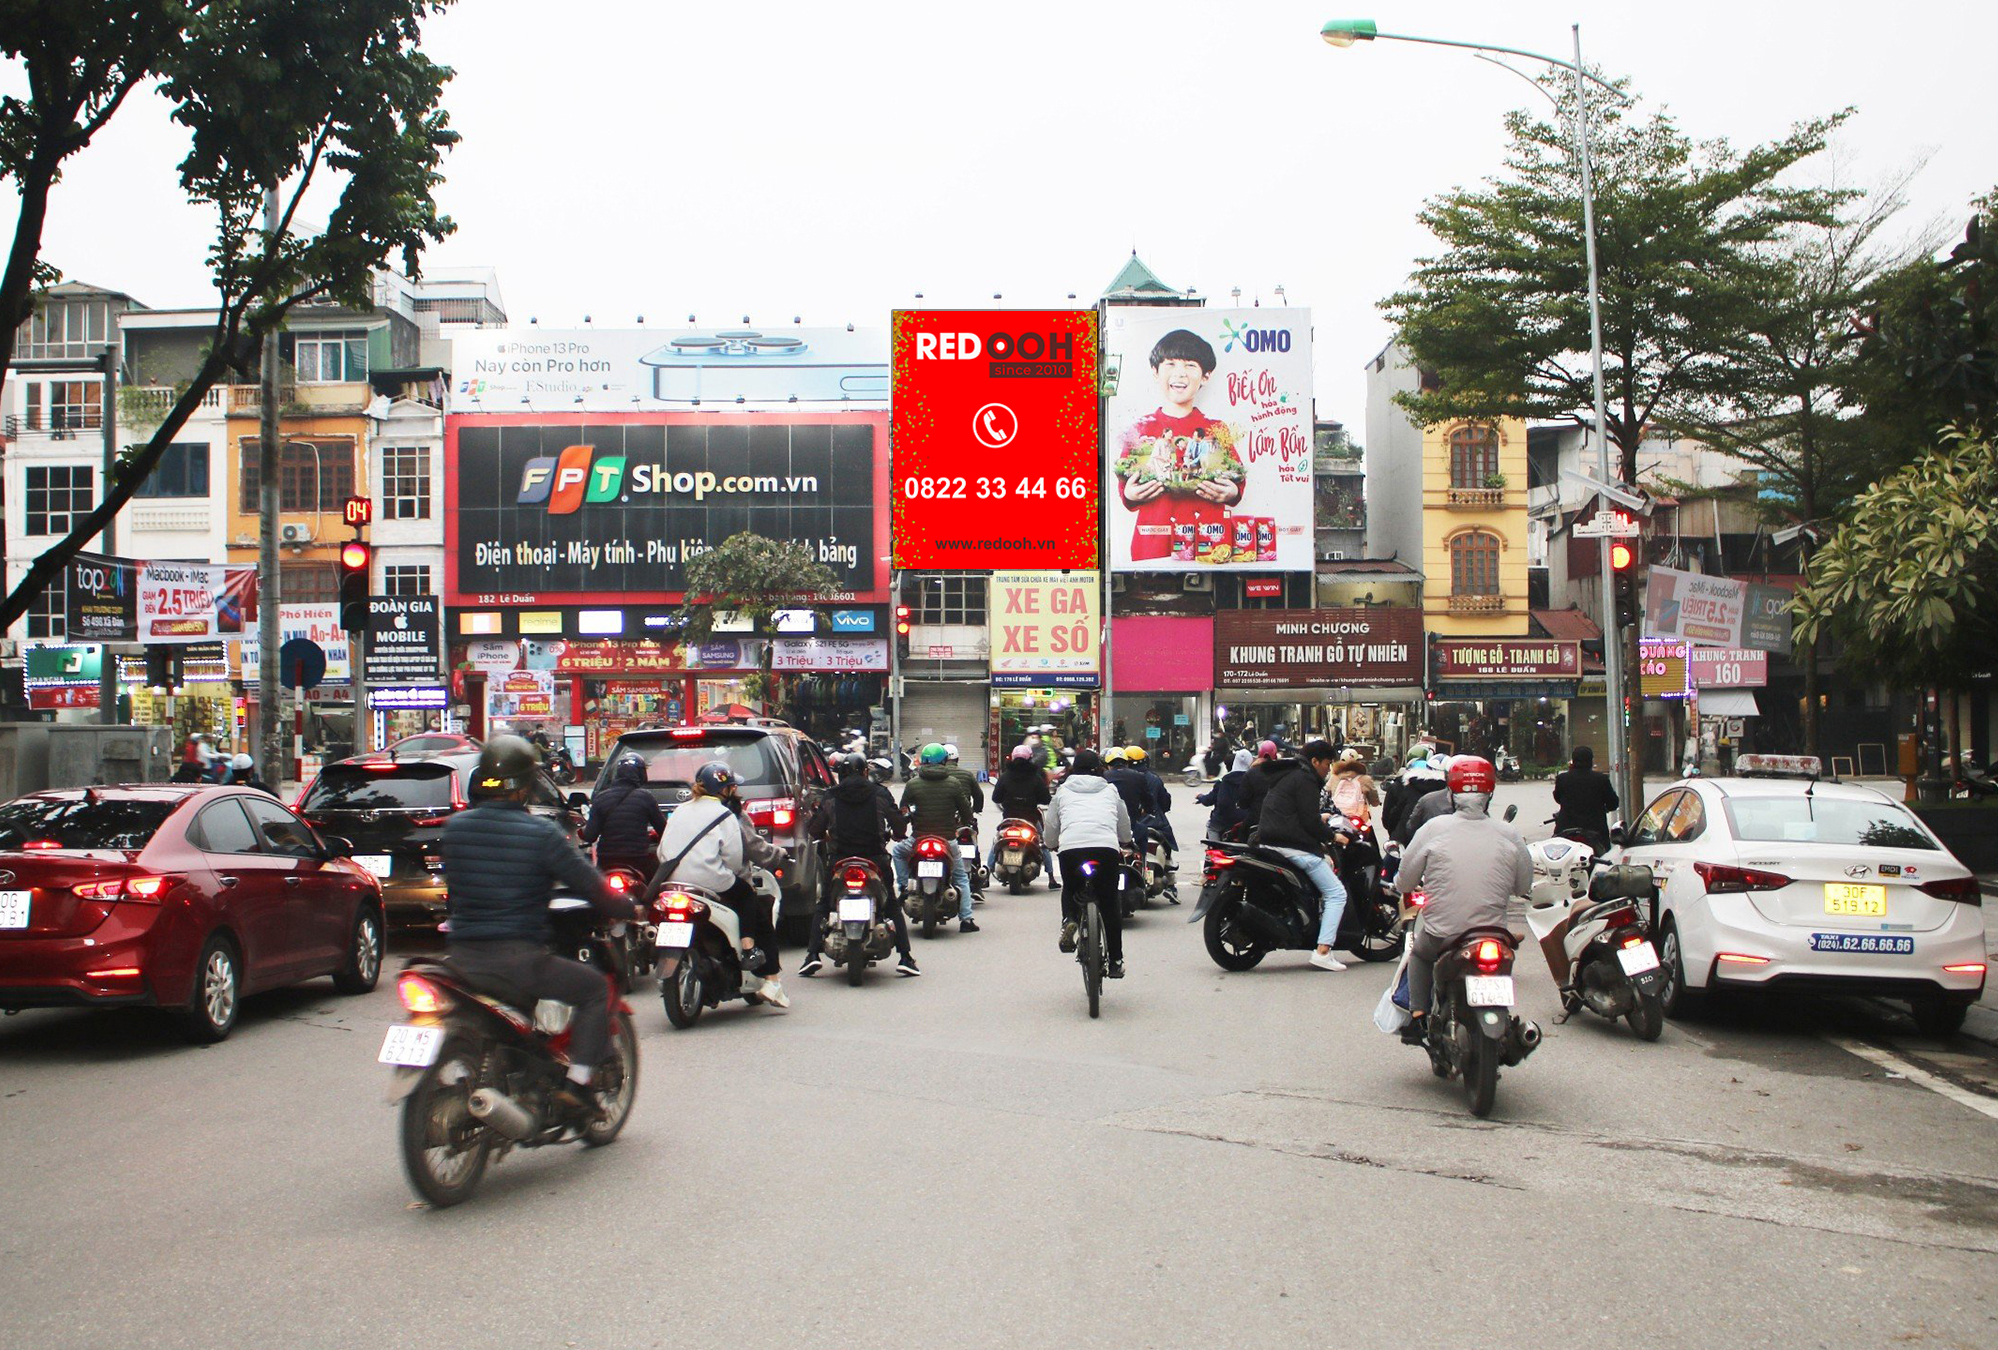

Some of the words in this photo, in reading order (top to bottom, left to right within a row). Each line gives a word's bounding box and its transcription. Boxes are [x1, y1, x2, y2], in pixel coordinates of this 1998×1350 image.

[916, 332, 982, 360] RED
[986, 332, 1073, 360] OOH
[1246, 330, 1291, 352] OMO
[507, 342, 551, 354] iPhone
[553, 343, 566, 354] 13
[568, 343, 590, 354] Pro
[475, 360, 506, 375] Nay
[512, 359, 542, 372] còn
[546, 360, 574, 372] Pro
[580, 358, 611, 372] hơn
[994, 364, 1031, 376] since
[1035, 364, 1067, 376] 2010
[1251, 410, 1274, 422] hành
[1274, 406, 1297, 416] động
[632, 464, 818, 500] Shop.com.vn
[904, 476, 967, 499] 0822
[976, 476, 1007, 499] 33
[1015, 476, 1047, 499] 44
[1055, 476, 1087, 499] 66
[346, 500, 367, 521] 04
[1182, 526, 1196, 534] OM
[1206, 526, 1224, 534] OMO
[1235, 532, 1252, 541] OMO
[935, 537, 1056, 550] www.redooh.vn
[475, 542, 511, 572] Điện
[516, 540, 557, 572] thoại
[568, 540, 600, 570] Máy
[604, 538, 634, 564] tính
[647, 540, 676, 570] Phụ
[819, 536, 857, 569] bảng
[1248, 584, 1261, 592] WE
[1263, 584, 1279, 592] WIN
[158, 588, 182, 615] 2.5
[478, 594, 496, 604] 182
[500, 594, 510, 603] Lê
[1004, 588, 1040, 614] XE
[1050, 588, 1088, 614] GA
[369, 598, 407, 613] ĐOÀN
[410, 600, 432, 614] GIA
[522, 616, 558, 626] realme
[836, 616, 870, 626] vivo
[1002, 626, 1040, 653] XE
[1050, 615, 1090, 653] SỐ
[1276, 624, 1308, 634] MINH
[1311, 622, 1370, 634] CHƯƠNG
[376, 631, 426, 642] MOBILE
[550, 646, 564, 654] 0%
[606, 640, 617, 648] 13
[477, 652, 510, 660] iPhone
[1230, 646, 1276, 664] KHUNG
[1280, 645, 1323, 663] TRANH
[1326, 636, 1344, 662] GỖ
[1348, 644, 1366, 667] TỰ
[1368, 640, 1408, 662] NHIÊN
[1452, 647, 1486, 667] TƯỢNG
[1490, 644, 1503, 664] GỖ
[1510, 649, 1544, 664] TRANH
[1546, 644, 1560, 664] GỖ
[1692, 651, 1726, 662] KHUNG
[1730, 650, 1764, 660] TRANH
[562, 658, 570, 667] 6
[575, 656, 613, 668] TRIỆU
[626, 658, 634, 666] 2
[636, 656, 670, 666] NĂM
[777, 656, 784, 665] 3
[786, 656, 814, 668] Triệu
[826, 656, 833, 665] 3
[836, 656, 863, 668] Triệu
[1715, 663, 1742, 684] 160
[1843, 887, 1867, 898] 30F
[1833, 900, 1879, 913] 519.12
[1817, 937, 1911, 952] (024).62.66.66.66
